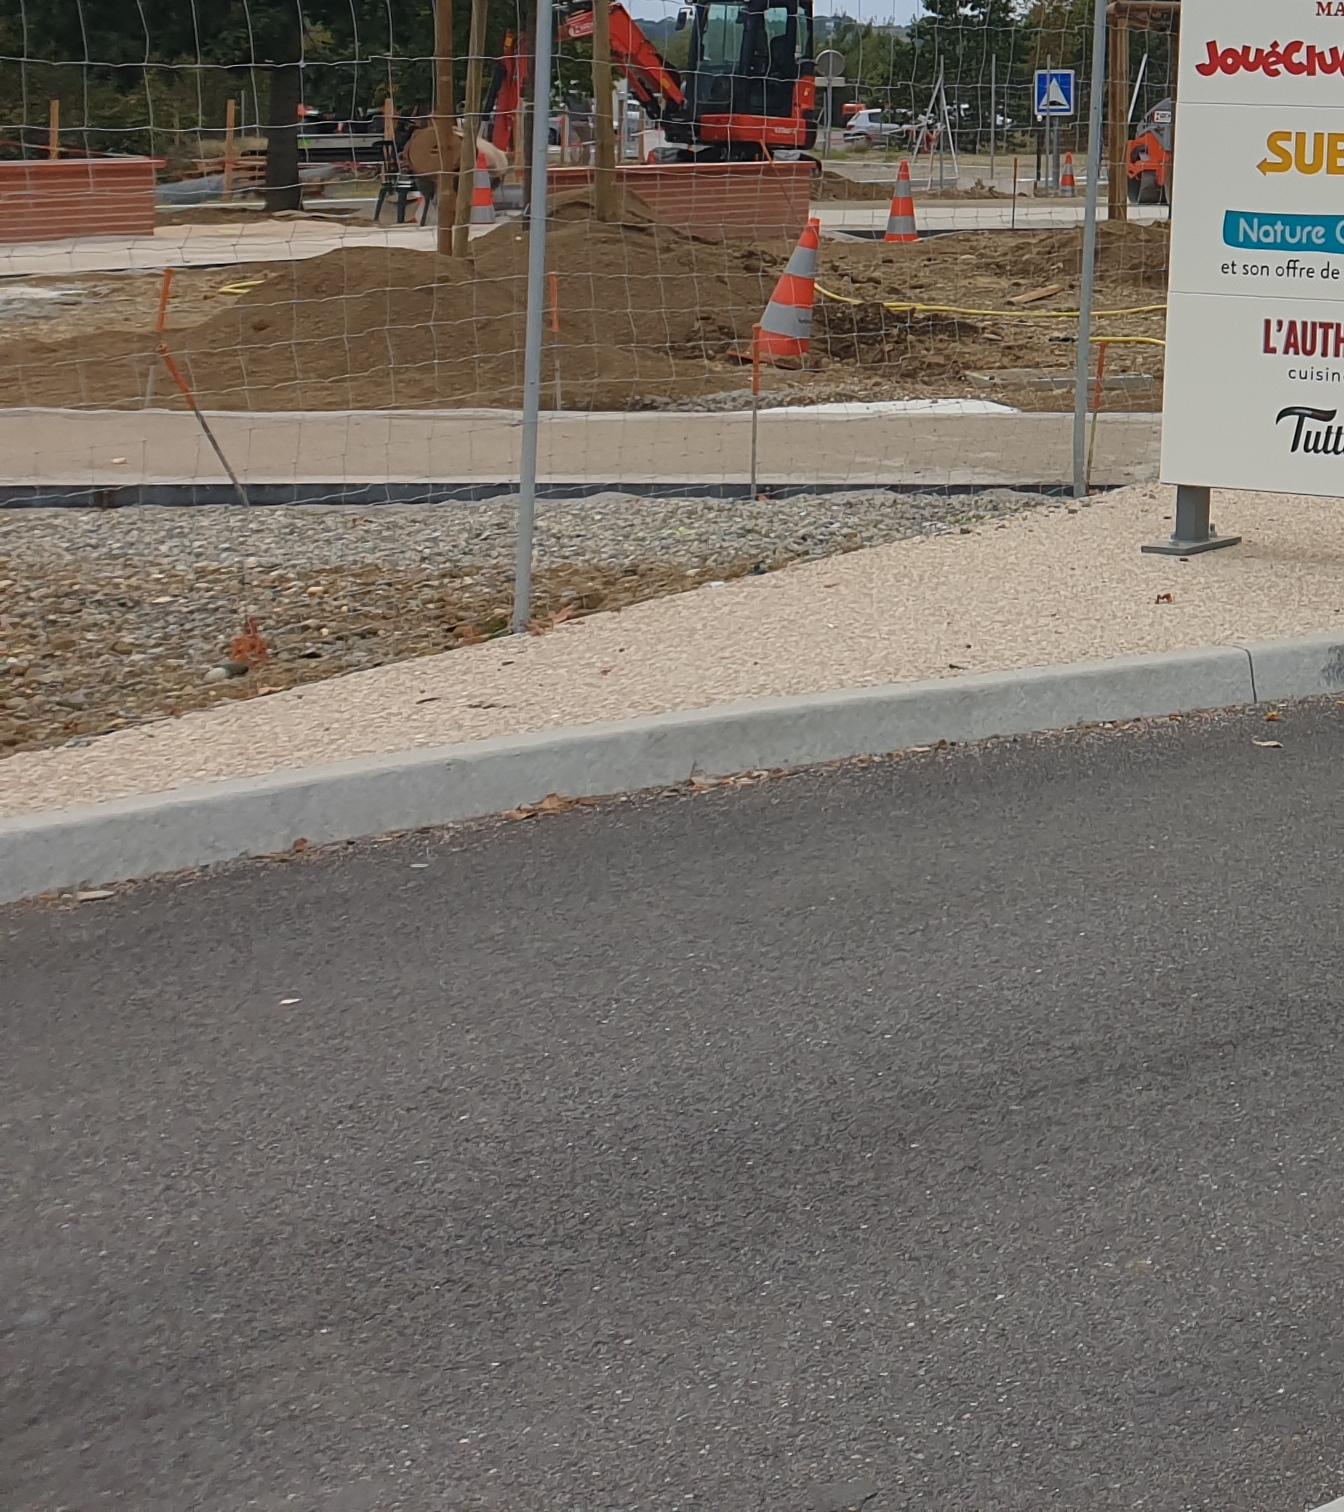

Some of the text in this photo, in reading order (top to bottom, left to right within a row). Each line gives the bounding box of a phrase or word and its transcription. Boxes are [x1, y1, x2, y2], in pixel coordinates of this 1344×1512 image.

[1237, 216, 1326, 246] Nature
[1220, 260, 1238, 276] et
[1242, 263, 1270, 277] son
[1275, 259, 1316, 279] offre
[1320, 260, 1341, 280] de
